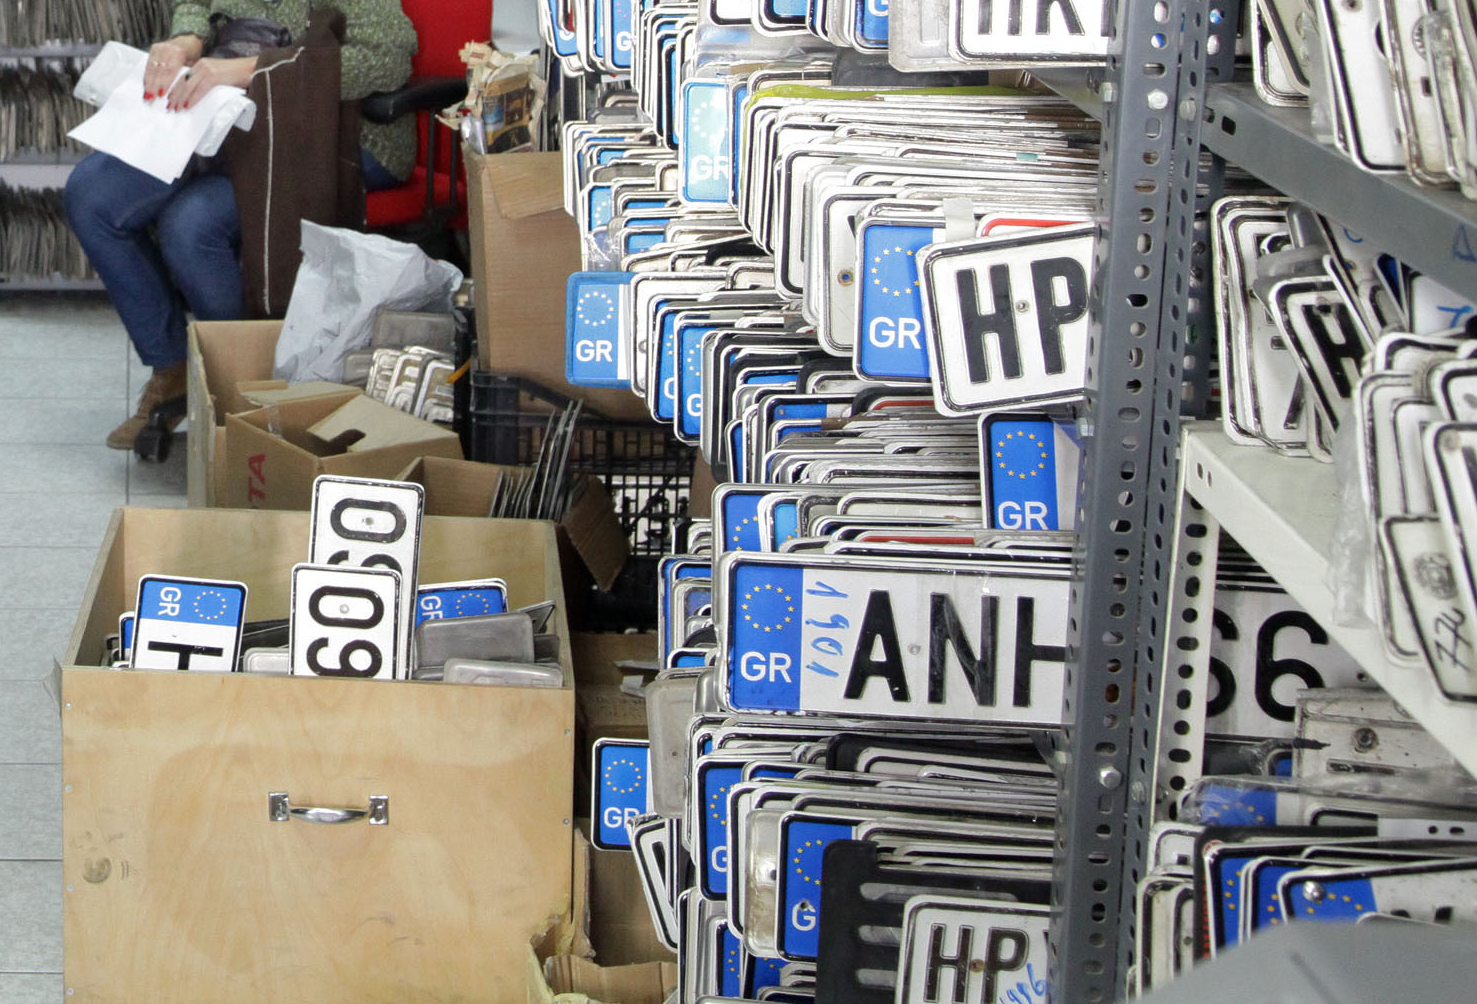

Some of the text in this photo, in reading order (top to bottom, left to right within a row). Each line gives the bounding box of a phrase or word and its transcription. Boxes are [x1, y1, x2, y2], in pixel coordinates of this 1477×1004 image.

[690, 155, 729, 181] GR
[869, 316, 922, 349] GR
[954, 255, 1090, 385] HP
[575, 339, 613, 363] GR
[247, 453, 266, 507] TA
[997, 500, 1049, 531] GR
[157, 586, 182, 617] GR
[843, 588, 1068, 708] ANH
[739, 651, 793, 683] GR
[711, 845, 728, 873] G
[791, 899, 817, 932] G
[924, 922, 1050, 1004] HP
